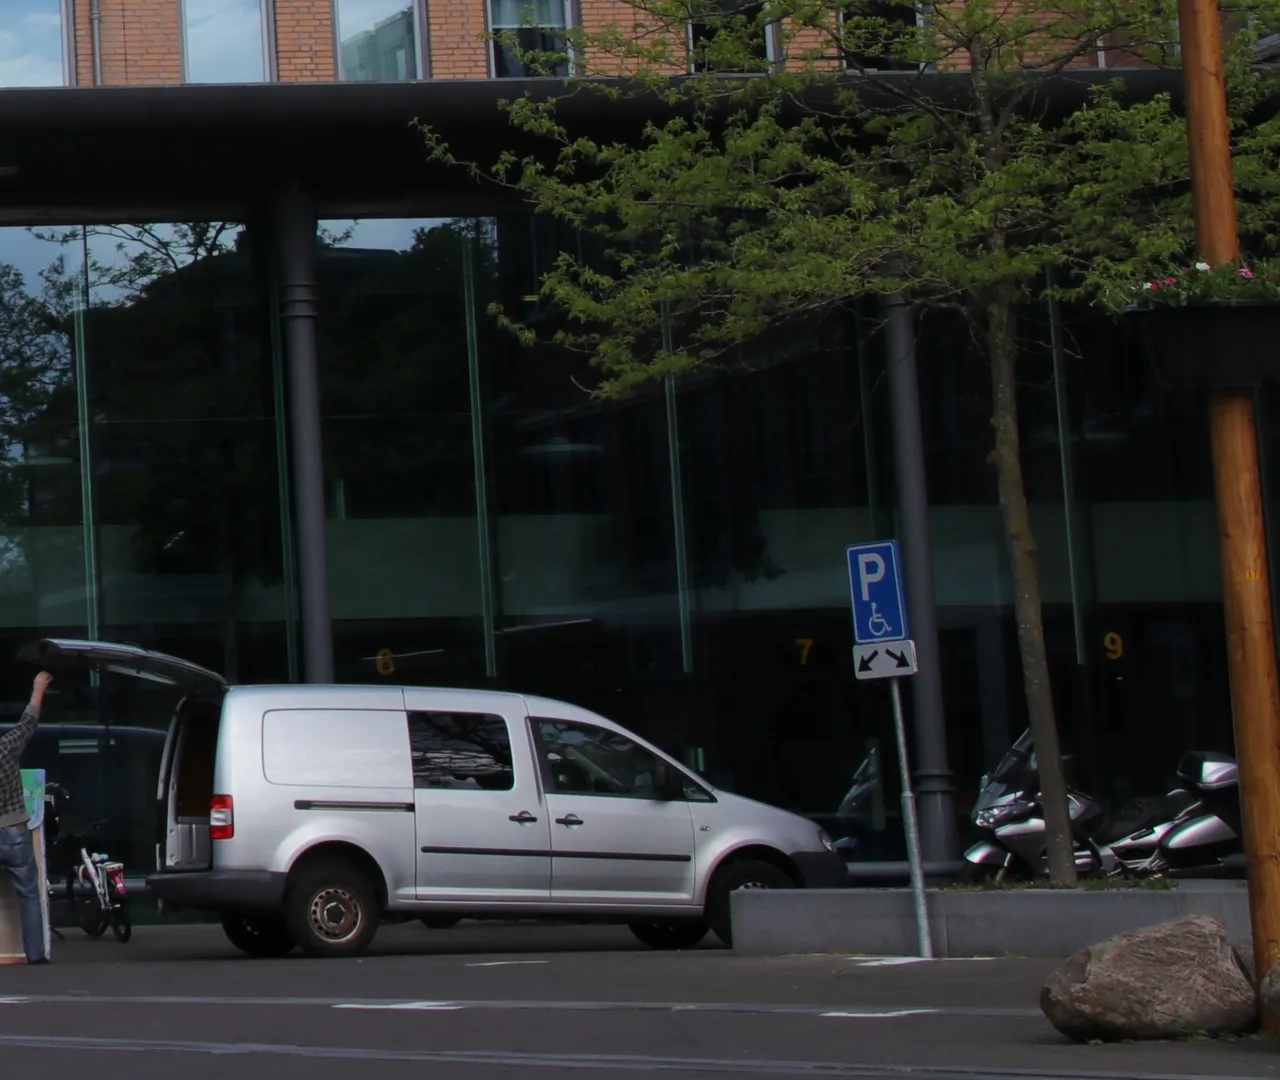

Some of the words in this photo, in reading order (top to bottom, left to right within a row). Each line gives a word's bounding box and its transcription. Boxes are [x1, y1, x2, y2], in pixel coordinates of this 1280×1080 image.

[857, 552, 886, 602] P
[794, 637, 814, 666] 7
[1103, 631, 1123, 660] 9
